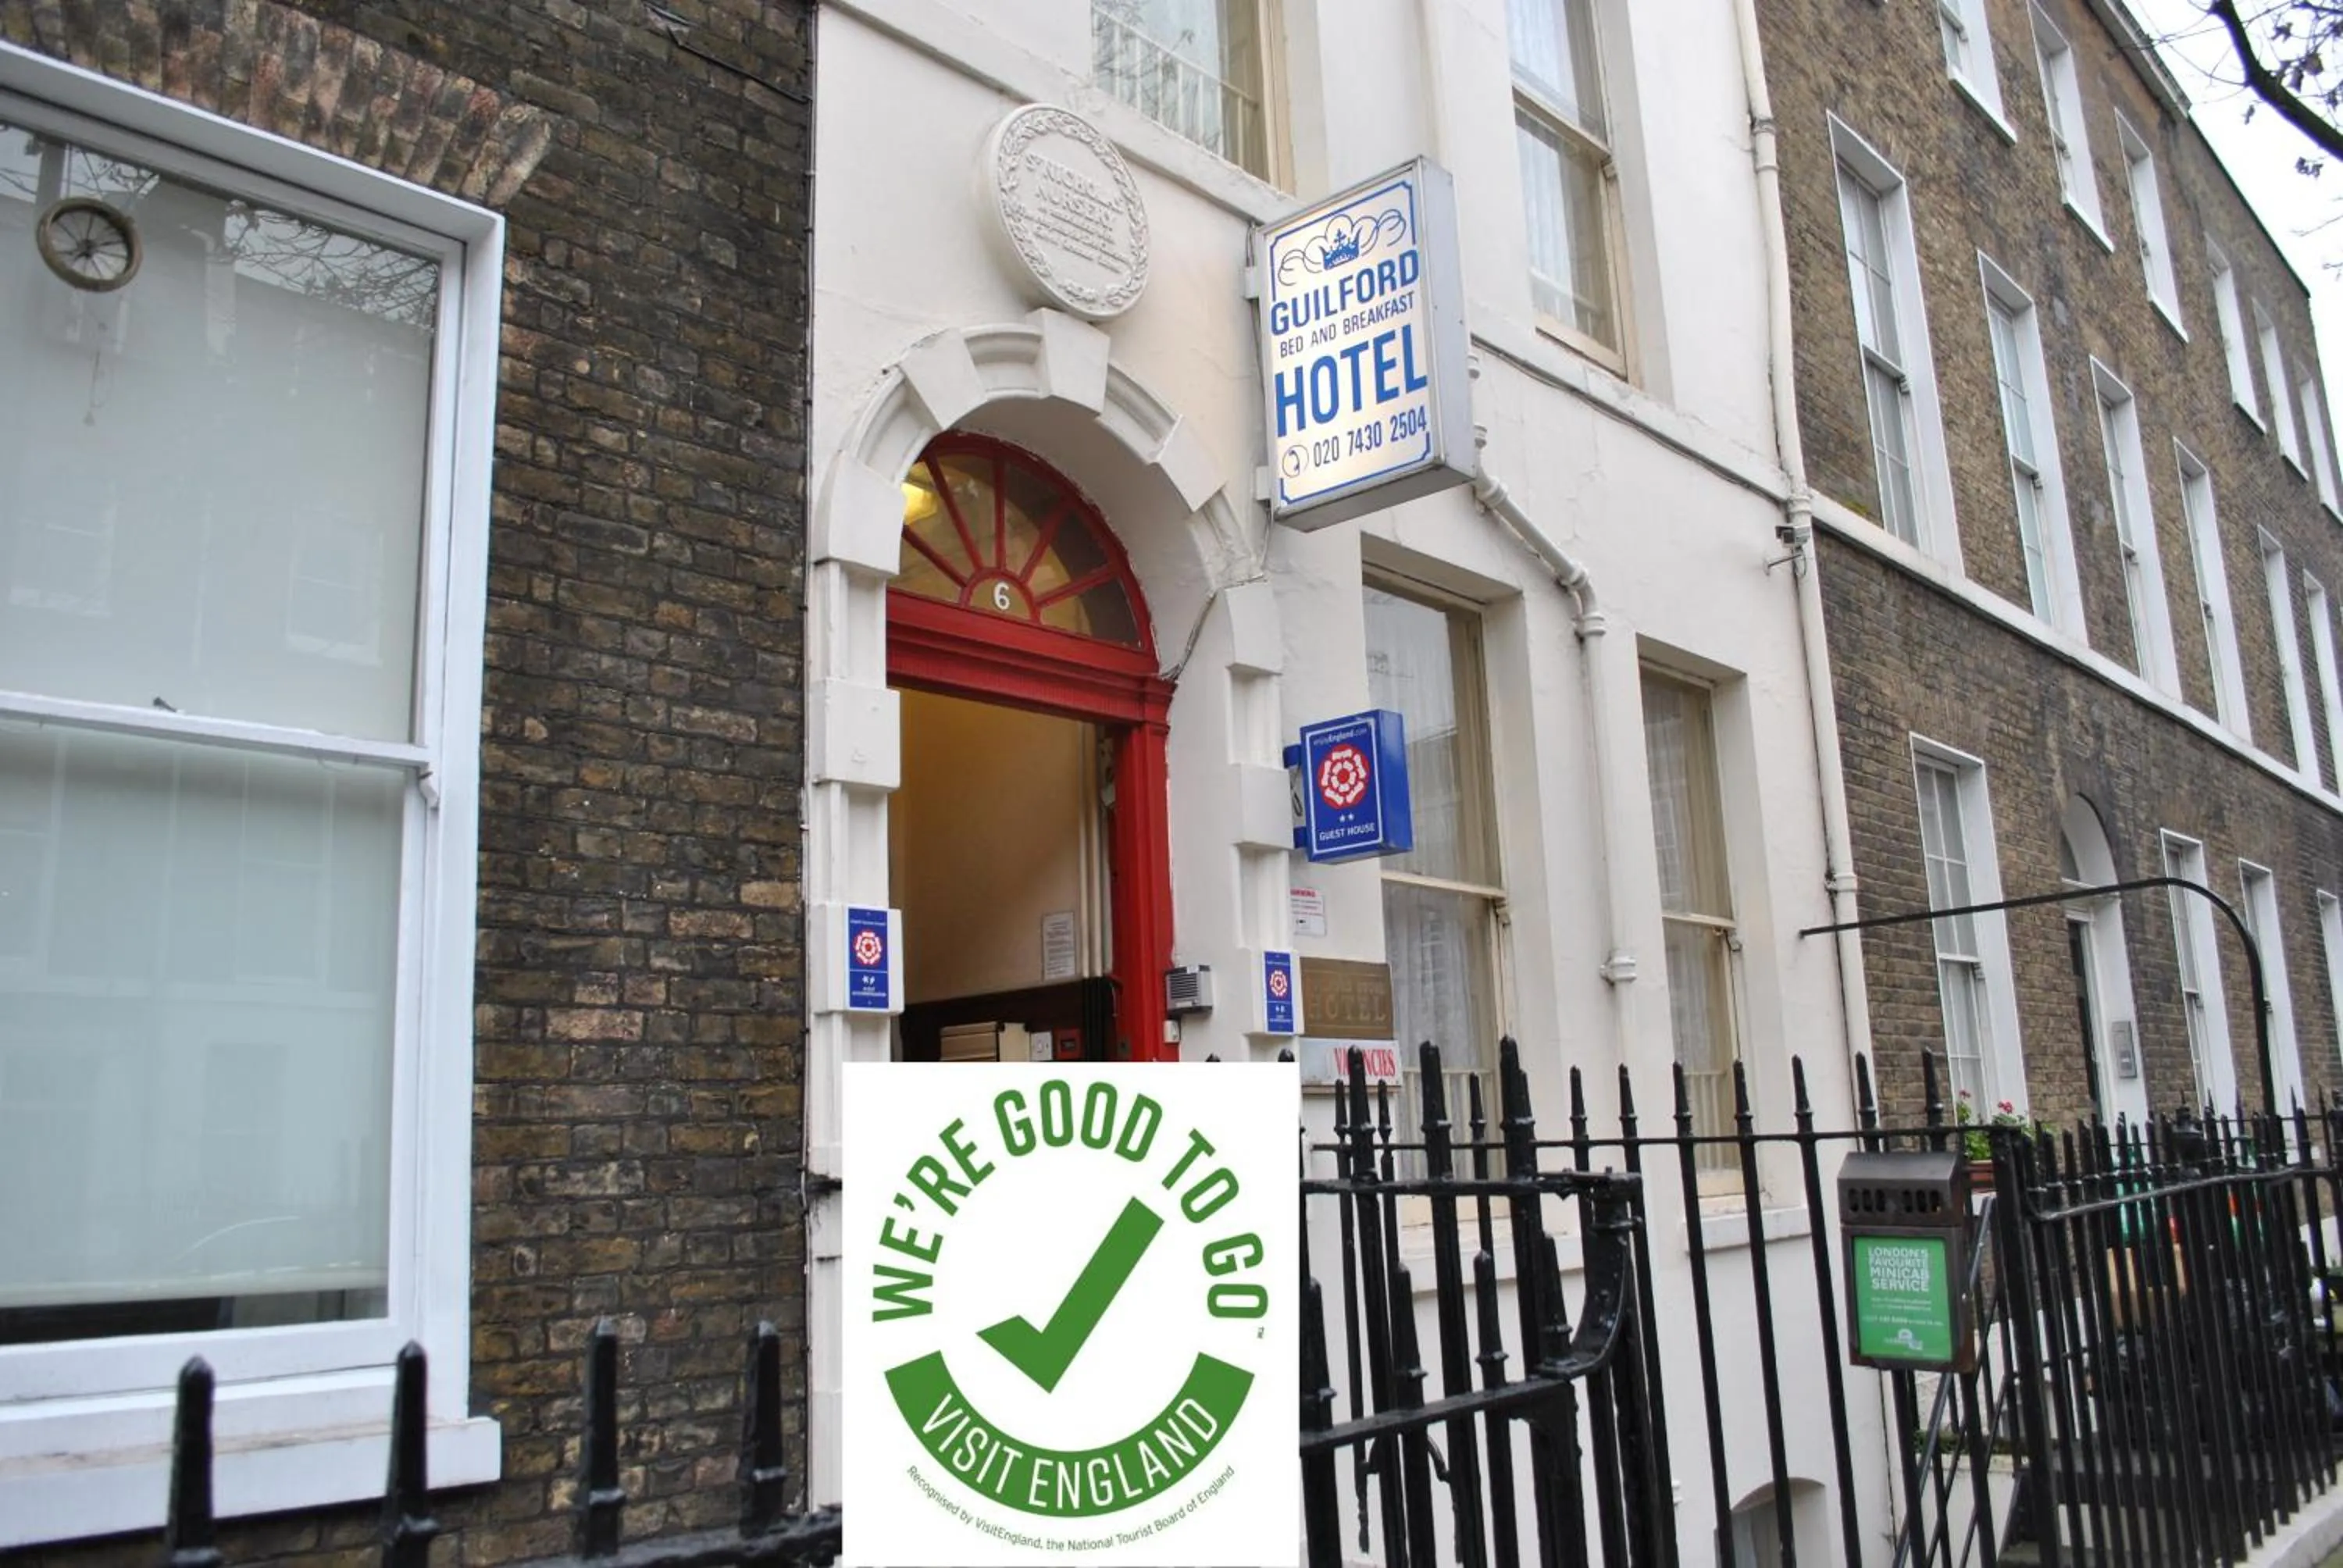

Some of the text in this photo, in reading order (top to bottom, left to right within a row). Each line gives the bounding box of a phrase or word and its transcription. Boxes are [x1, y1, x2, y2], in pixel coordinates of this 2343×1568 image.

[1271, 249, 1419, 335] GUILFORD
[1280, 291, 1414, 358] BED AND BREAKFAST
[1275, 323, 1428, 437] HOTEL
[1313, 406, 1427, 468] 020 7430 2504
[993, 582, 1010, 609] 6
[1319, 822, 1375, 841] GUEST HOUSE
[1307, 993, 1386, 1022] HOTEL
[1867, 1246, 1928, 1258] LONDON'S
[1868, 1256, 1929, 1268] FAVOURITE
[1870, 1267, 1930, 1280] MINICAB
[1871, 1278, 1930, 1292] SERVICE
